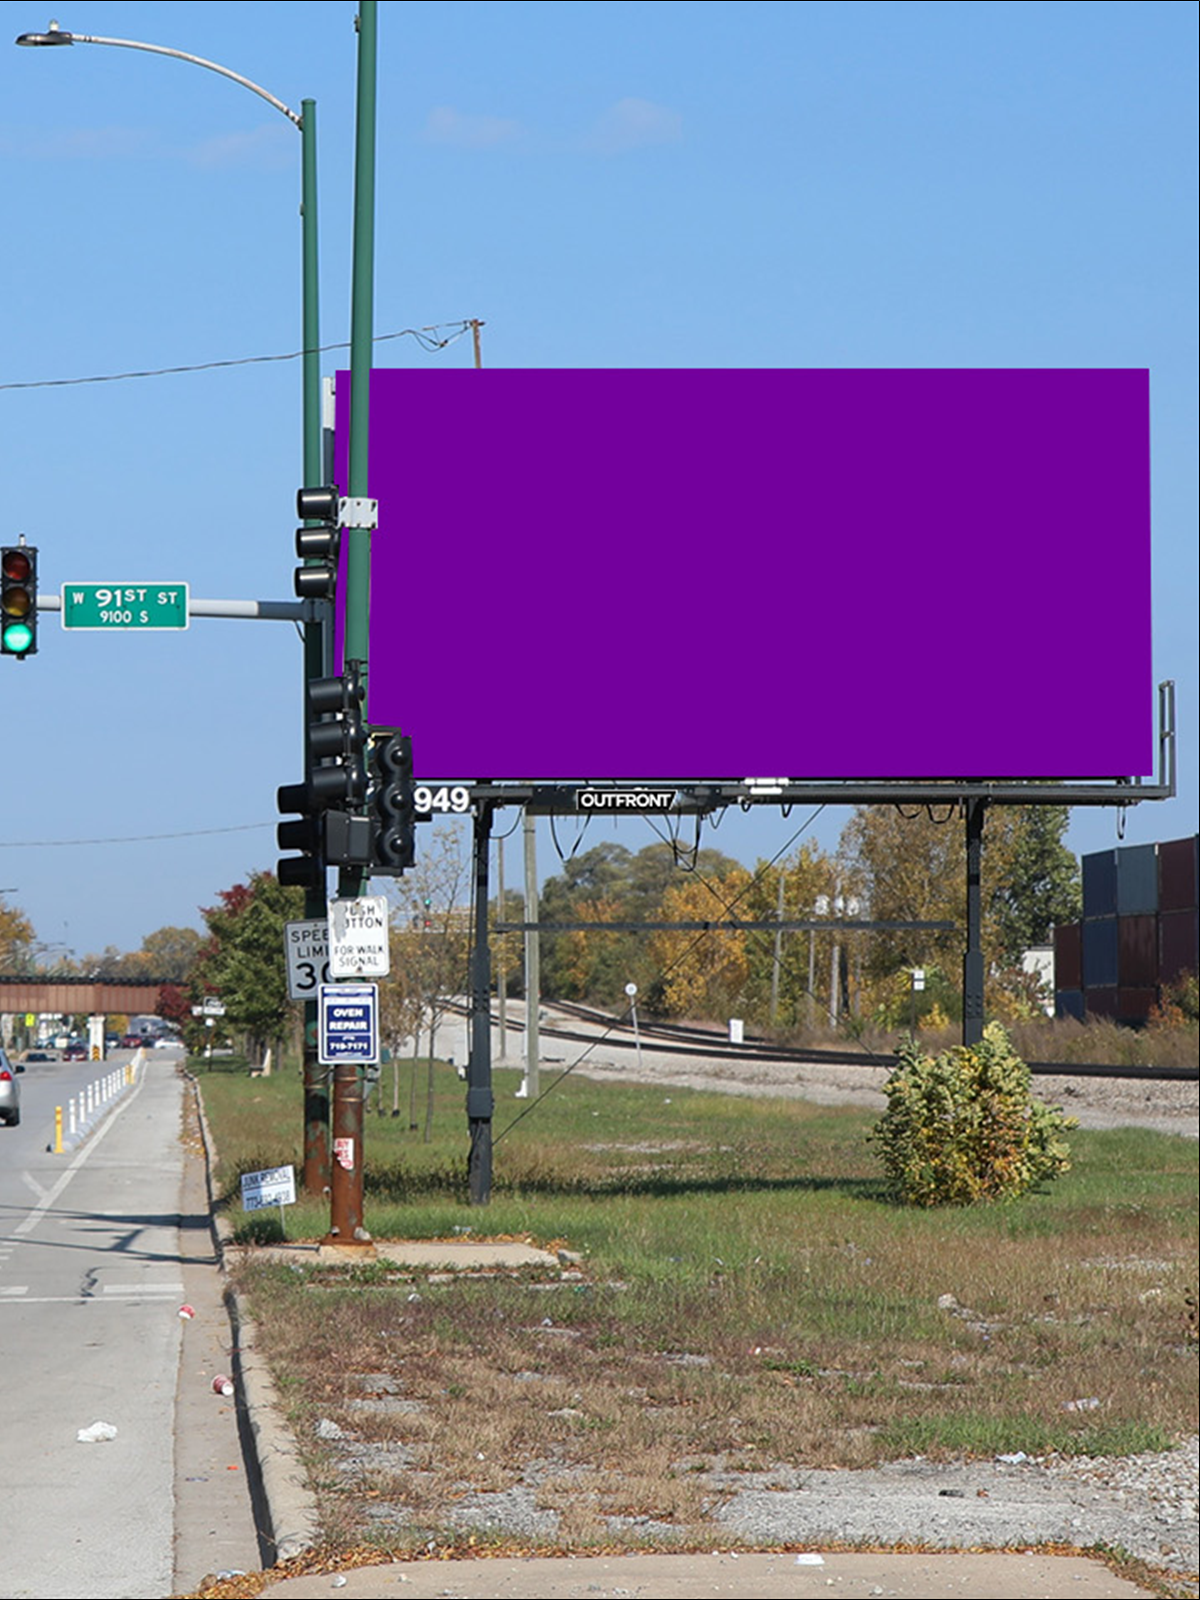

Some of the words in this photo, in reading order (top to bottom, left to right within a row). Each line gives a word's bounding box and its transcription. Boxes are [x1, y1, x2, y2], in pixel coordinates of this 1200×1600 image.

[72, 592, 85, 604] W
[95, 589, 147, 607] 91ST
[157, 592, 178, 604] ST
[100, 610, 132, 623] 9100
[140, 610, 149, 623] S
[413, 787, 469, 813] 949
[580, 793, 672, 808] OUTFRONT
[291, 929, 329, 943] SPEE
[297, 946, 329, 959] LIMI
[334, 945, 354, 955] FOR
[357, 945, 384, 954] WALK
[339, 956, 379, 967] SIGNAL
[333, 1008, 363, 1017] OVEN
[329, 1021, 368, 1030] REPAIR
